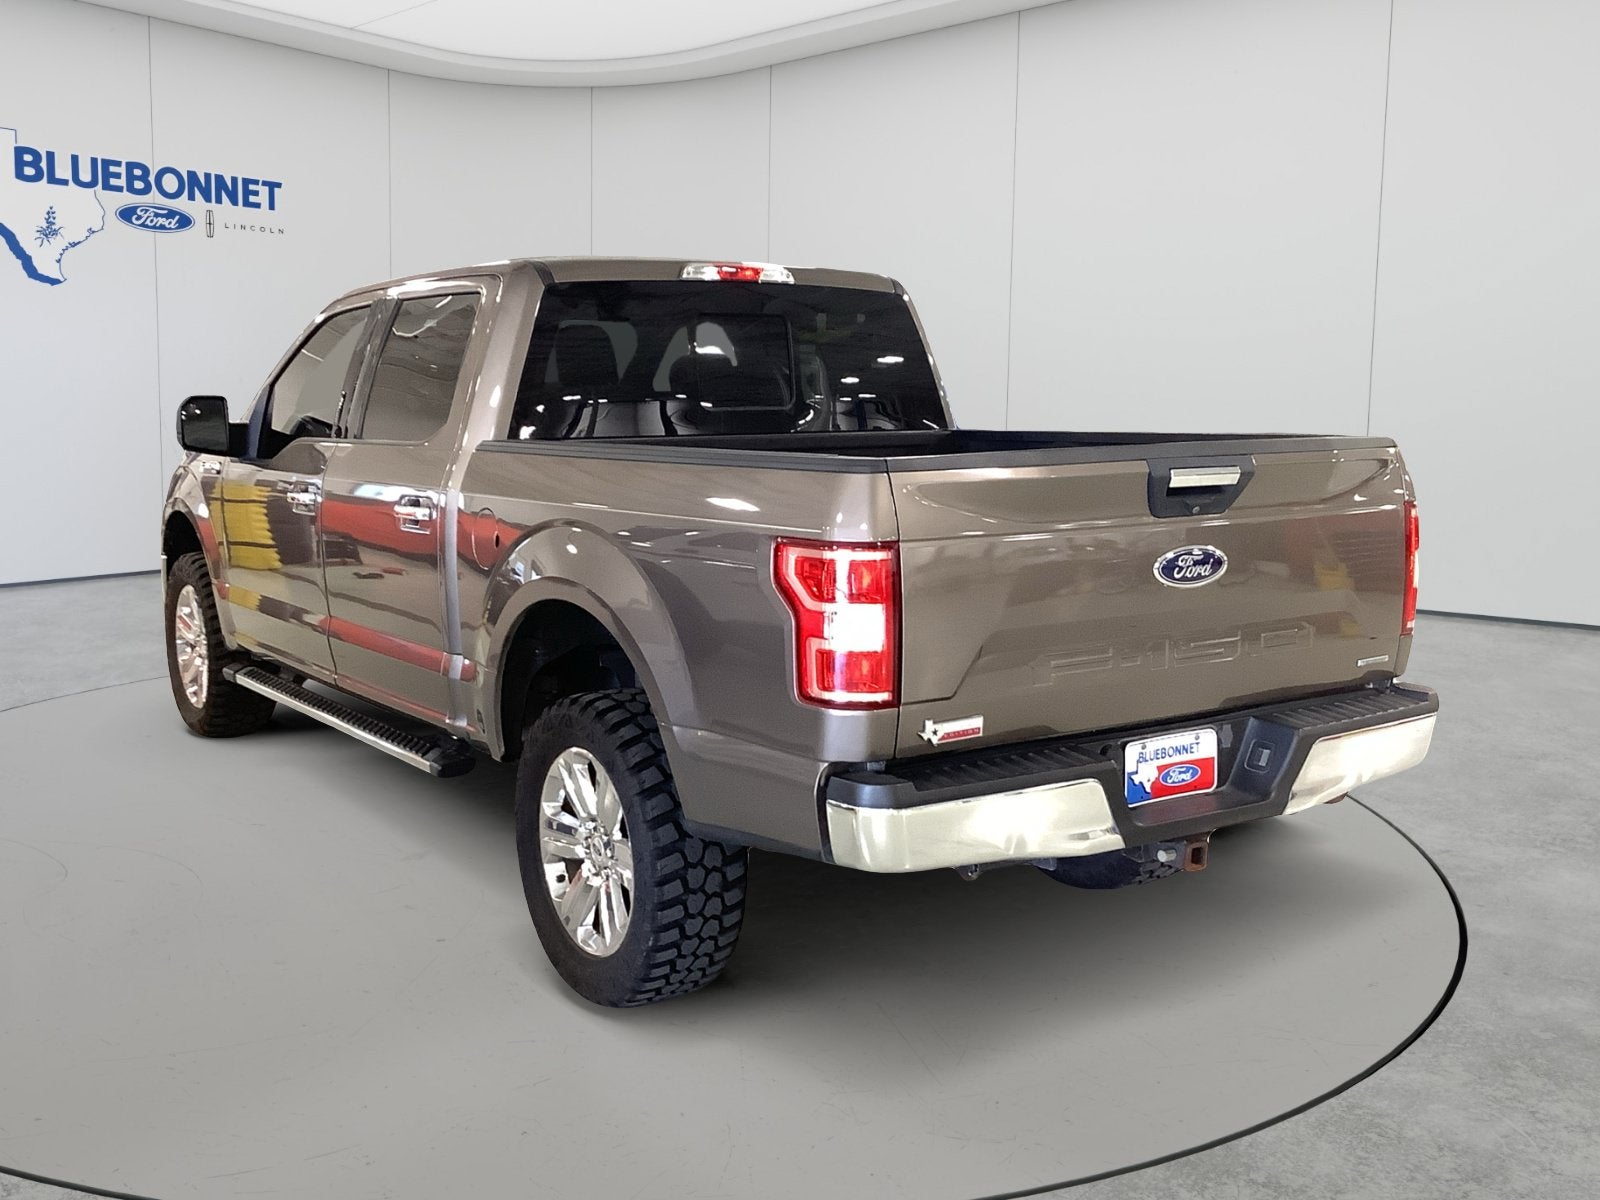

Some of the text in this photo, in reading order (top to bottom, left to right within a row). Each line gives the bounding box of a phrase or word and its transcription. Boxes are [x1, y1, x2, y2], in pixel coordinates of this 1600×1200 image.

[14, 145, 282, 211] BLUEBONNET
[131, 206, 285, 235] Ford LINCOLN
[1173, 552, 1214, 579] Ford
[1138, 742, 1200, 763] BLUEBONNET
[1166, 767, 1193, 784] Ford
